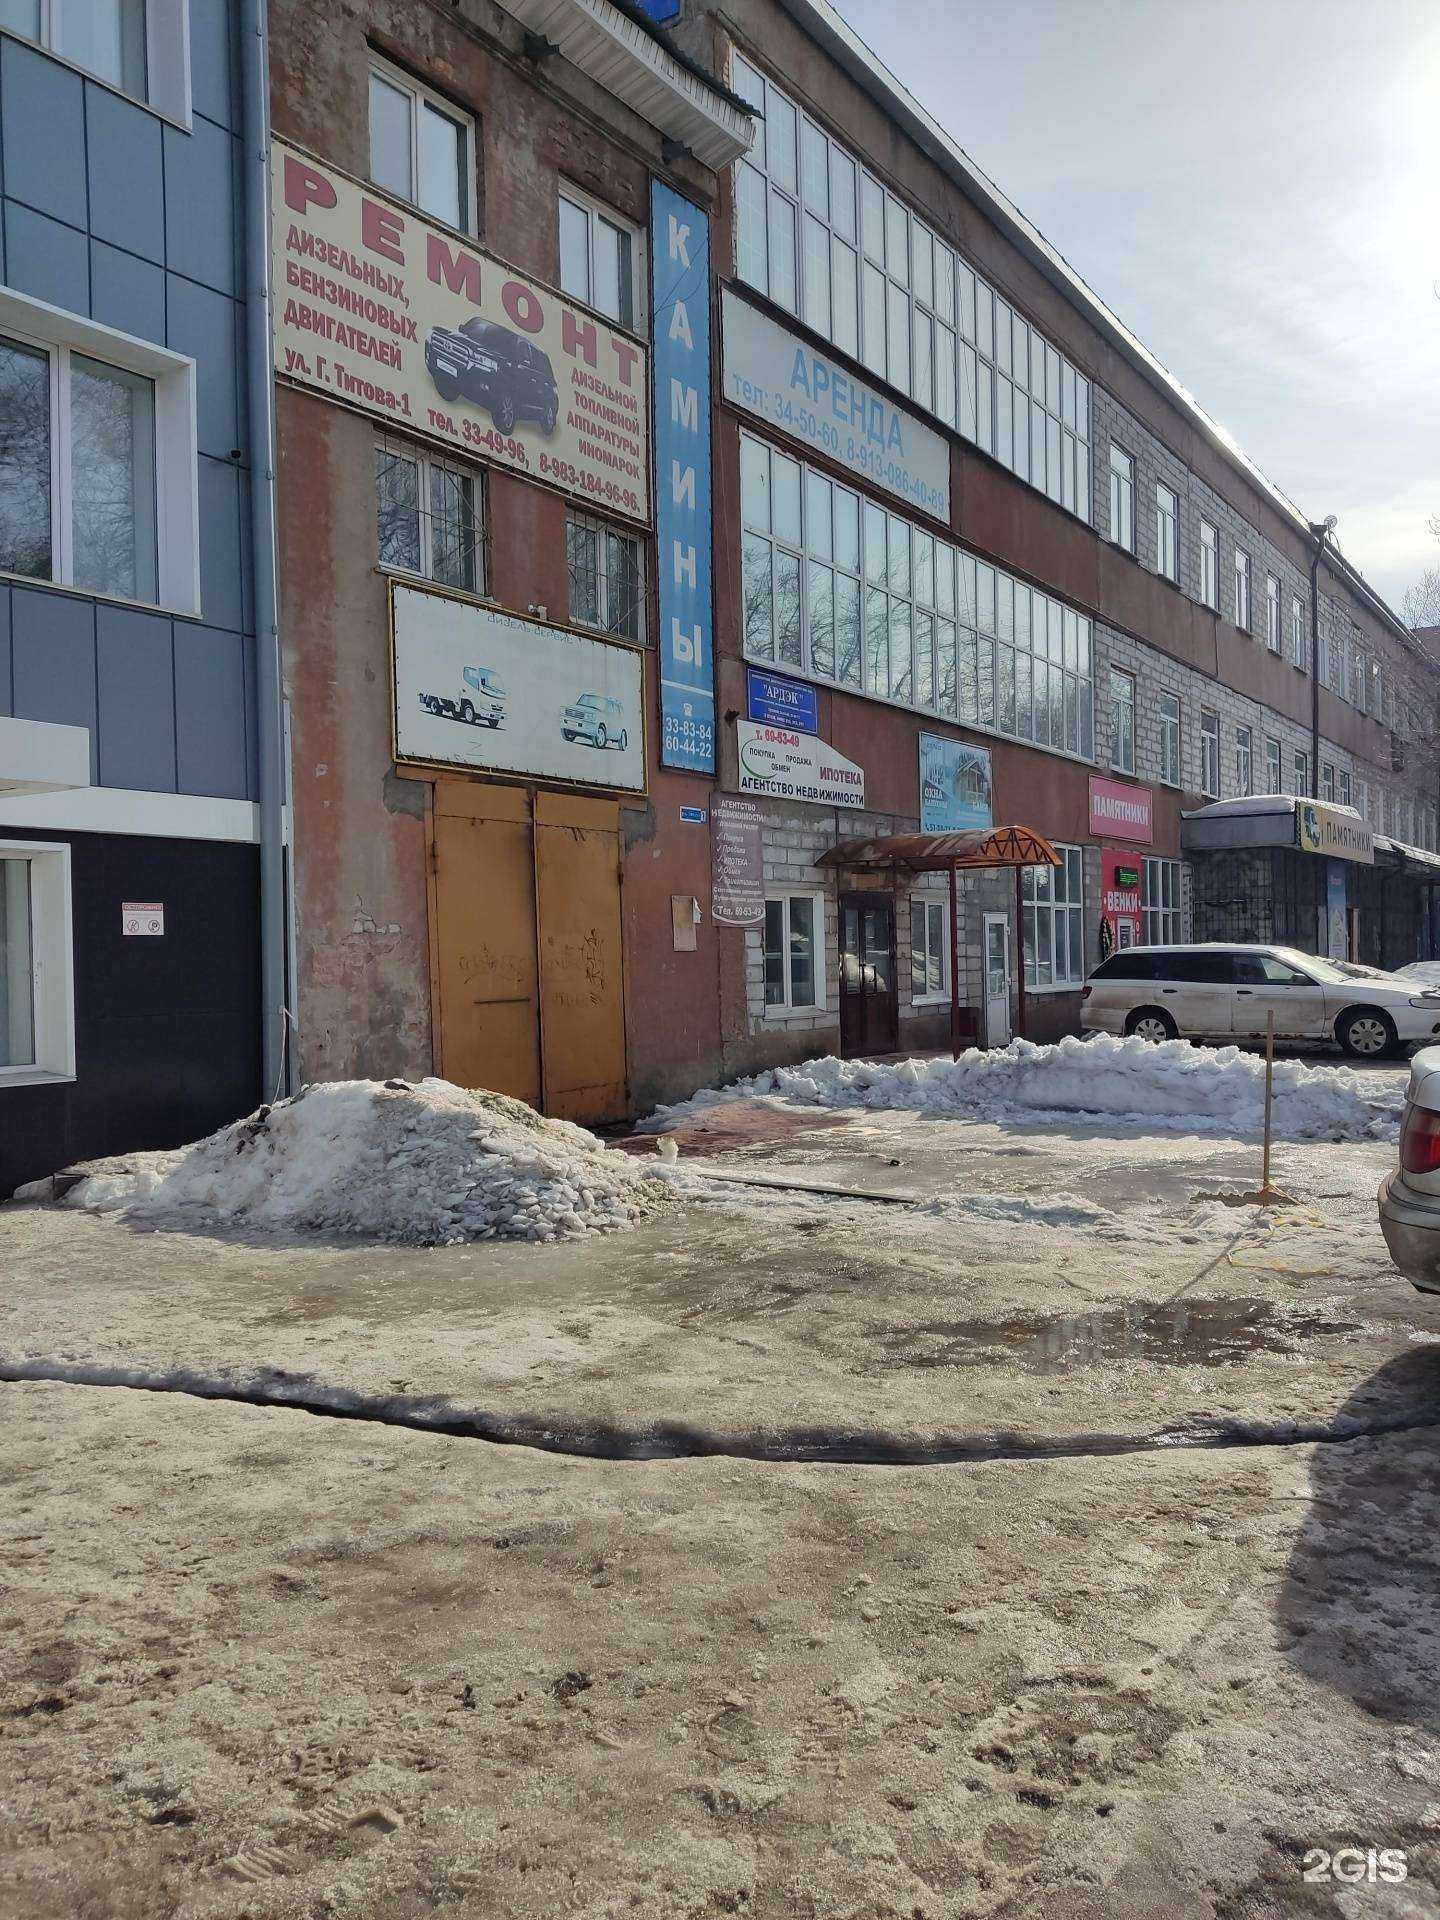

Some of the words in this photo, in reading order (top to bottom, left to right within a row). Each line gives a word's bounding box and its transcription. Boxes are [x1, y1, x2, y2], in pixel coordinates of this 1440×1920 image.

[284, 154, 638, 388] РЕМОНТ
[286, 224, 410, 308] ДИЗЕЛЬНЫХ,
[286, 259, 418, 344] БЕНЗИНОВЫХ
[284, 299, 402, 370] ДВИГАТЕЛЕЙ
[284, 347, 311, 375] ул.
[316, 359, 330, 383] Г.
[336, 362, 412, 416] Титова-1
[571, 368, 638, 412] ДИЗЕЛЬНОЙ
[790, 348, 904, 458] АРЕНДА
[566, 411, 640, 458] АППАРАТУРЫ
[574, 390, 640, 435] ТОПЛИВНОЙ
[427, 407, 459, 435] тел.
[461, 419, 529, 469] 33-49-96,
[578, 438, 641, 480] ИНОМАРОК
[668, 214, 703, 669] КАМИНЫ
[665, 717, 712, 740] 33-83-84
[665, 736, 712, 759] 60-44-22
[749, 748, 776, 760] ПОКУПКА
[785, 755, 812, 767] ПРОДАЖА
[771, 763, 791, 773] ОБМЕН
[819, 766, 862, 786] ИПОТЕКА
[741, 777, 794, 795] АГЕНТСТВО
[796, 785, 864, 805] НЕДВИЖИМОСТИ
[1093, 795, 1149, 826] ПАМЯТНИКИ
[1326, 821, 1371, 852] ПАМЯТНИКИ
[1107, 891, 1138, 912] ВЕНКИ
